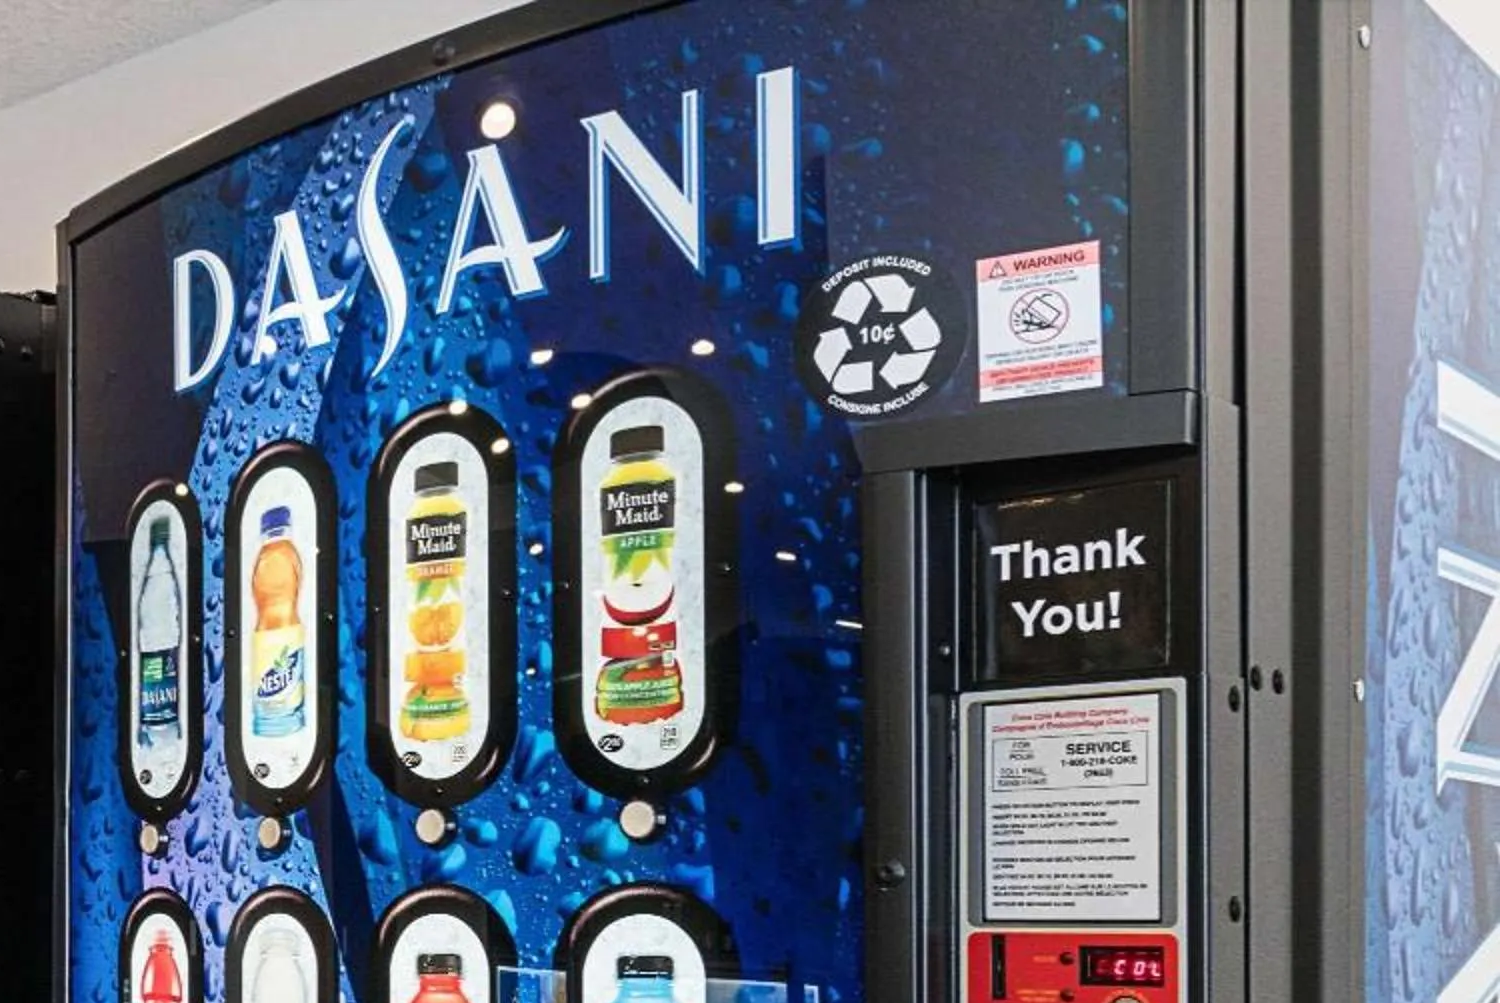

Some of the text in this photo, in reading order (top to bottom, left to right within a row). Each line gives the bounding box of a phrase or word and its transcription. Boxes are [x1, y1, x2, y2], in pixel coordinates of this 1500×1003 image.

[173, 66, 797, 392] DASANI
[1014, 249, 1085, 271] WARNING
[821, 256, 932, 292] DEPOSIT INCLUDED
[859, 323, 895, 345] 10¢
[607, 489, 669, 511] Minute
[615, 505, 660, 526] Maid
[411, 522, 462, 541] Minute
[621, 535, 657, 548] APPLE
[418, 536, 454, 555] Maid
[990, 527, 1147, 581] Thank
[1011, 591, 1121, 637] You!
[1066, 740, 1132, 756] SERVICE
